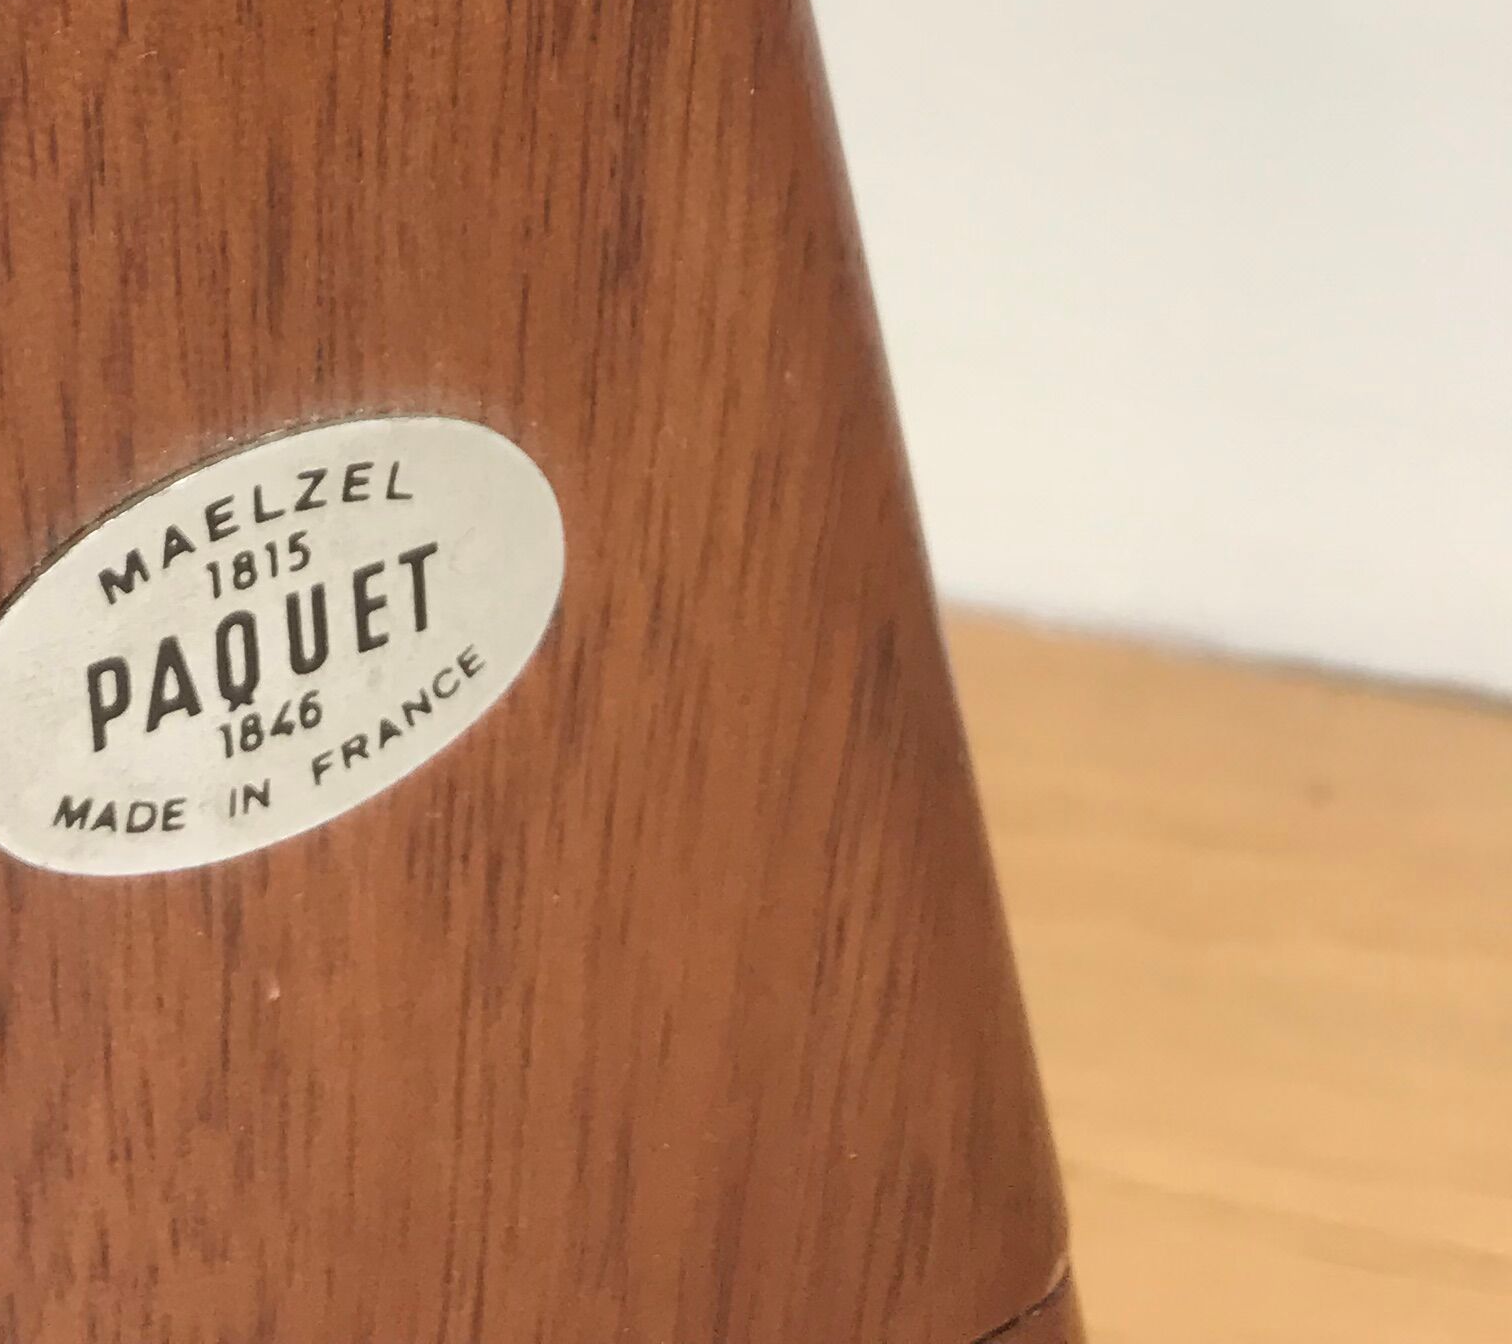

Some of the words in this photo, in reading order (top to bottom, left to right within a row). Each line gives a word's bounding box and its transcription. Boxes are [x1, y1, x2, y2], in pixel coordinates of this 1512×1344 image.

[97, 461, 414, 605] MAELZEL
[205, 530, 312, 599] 1815
[86, 541, 440, 753] PAQUET
[51, 796, 187, 833] MADE
[228, 778, 271, 818] IN
[310, 643, 487, 786] FRANCE
[218, 690, 324, 759] 1846
